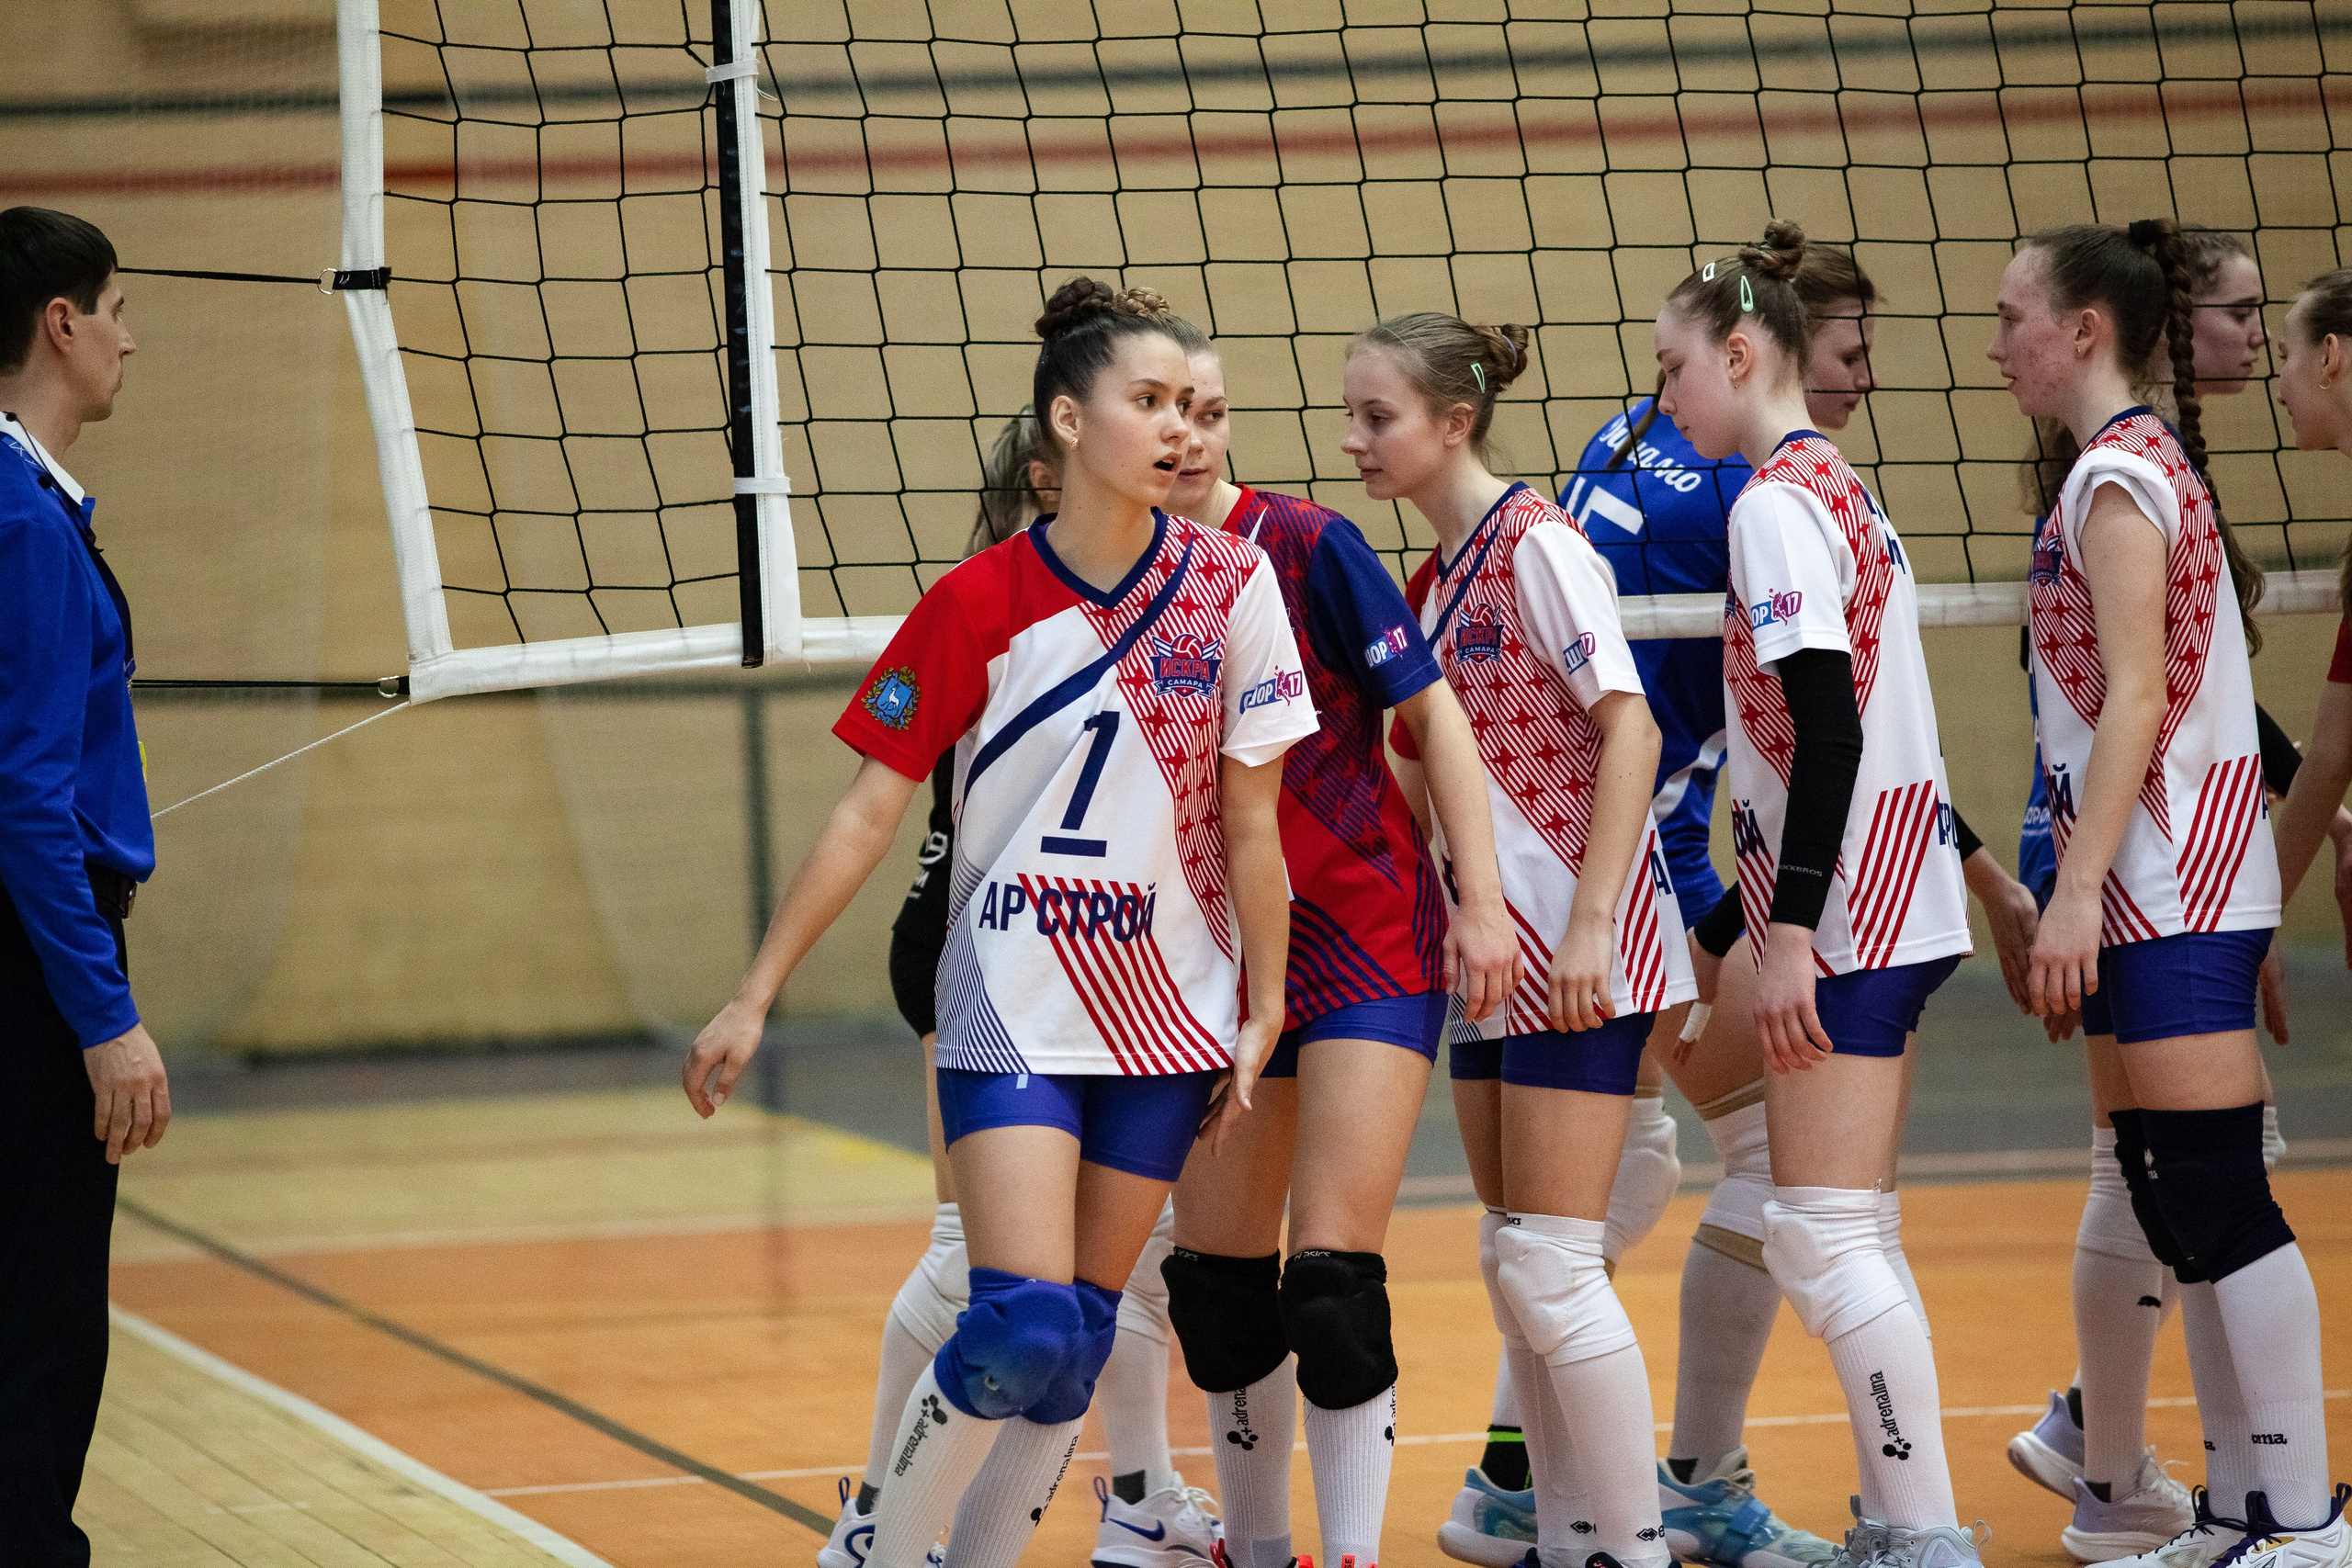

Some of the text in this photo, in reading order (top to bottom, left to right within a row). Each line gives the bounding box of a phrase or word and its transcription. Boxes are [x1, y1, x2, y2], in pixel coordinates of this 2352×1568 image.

[1785, 592, 1799, 615] 17
[1393, 626, 1408, 651] 17
[1464, 646, 1495, 654] САМАРА
[1160, 657, 1211, 681] ИСКРА
[1168, 679, 1204, 689] САМАРА
[1288, 672, 1301, 696] 17
[978, 881, 1026, 931] АР
[1036, 882, 1157, 942] СТРОЙ
[1231, 1386, 1250, 1427] adrena
[1869, 1370, 1900, 1438] adrenalina
[2251, 1433, 2289, 1445] oma
